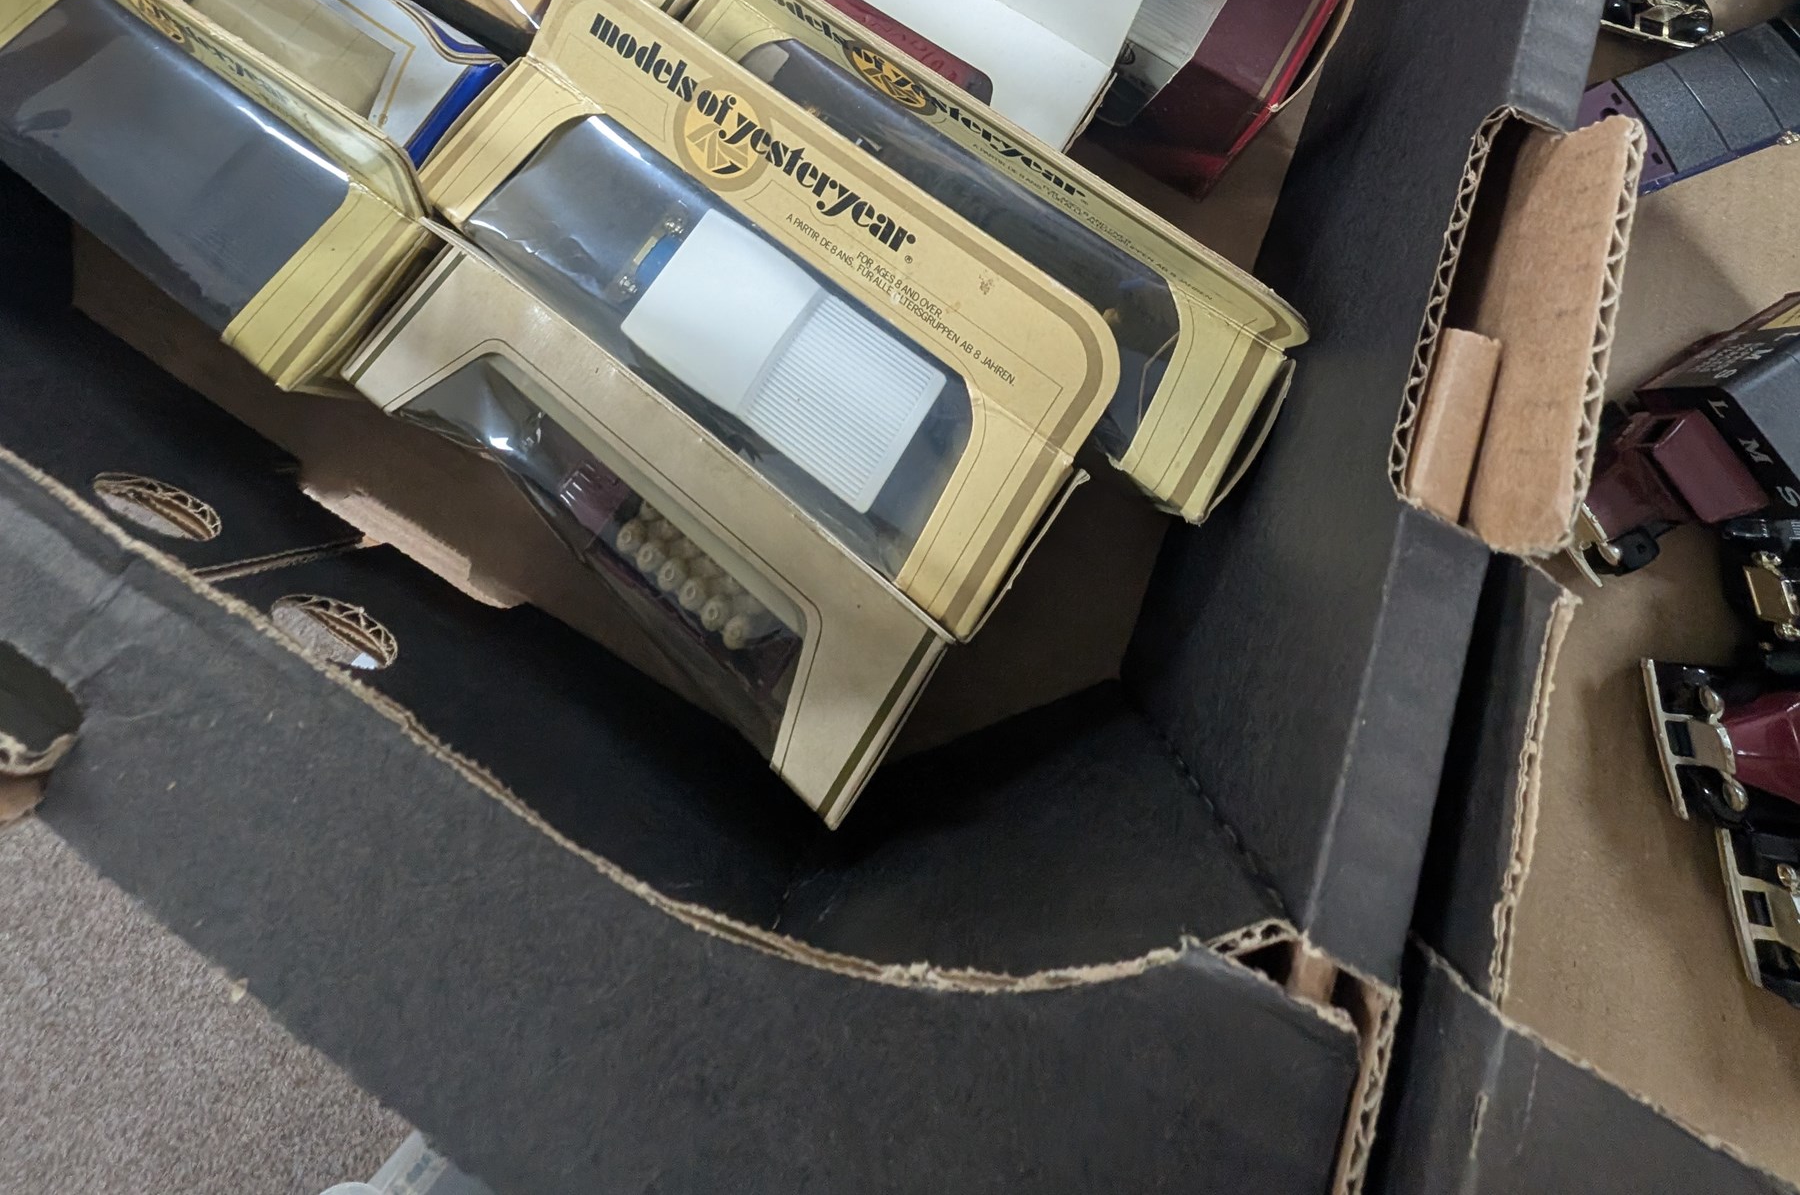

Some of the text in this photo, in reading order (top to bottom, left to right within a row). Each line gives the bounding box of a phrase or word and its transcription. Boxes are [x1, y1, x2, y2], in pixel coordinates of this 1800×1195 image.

[588, 12, 699, 104] models
[695, 88, 737, 128] of
[785, 213, 793, 223] A
[793, 217, 820, 241] PARTIR
[819, 237, 831, 251] DE
[830, 245, 837, 255] 8
[836, 251, 854, 268] ANS.
[872, 276, 892, 296] ALLE
[960, 340, 973, 354] AB
[973, 349, 982, 360] 8
[980, 356, 1016, 386] JAHREN.
[856, 251, 874, 271] FOR
[875, 262, 896, 285] AGES
[894, 279, 902, 288] 8
[901, 284, 921, 302] AND
